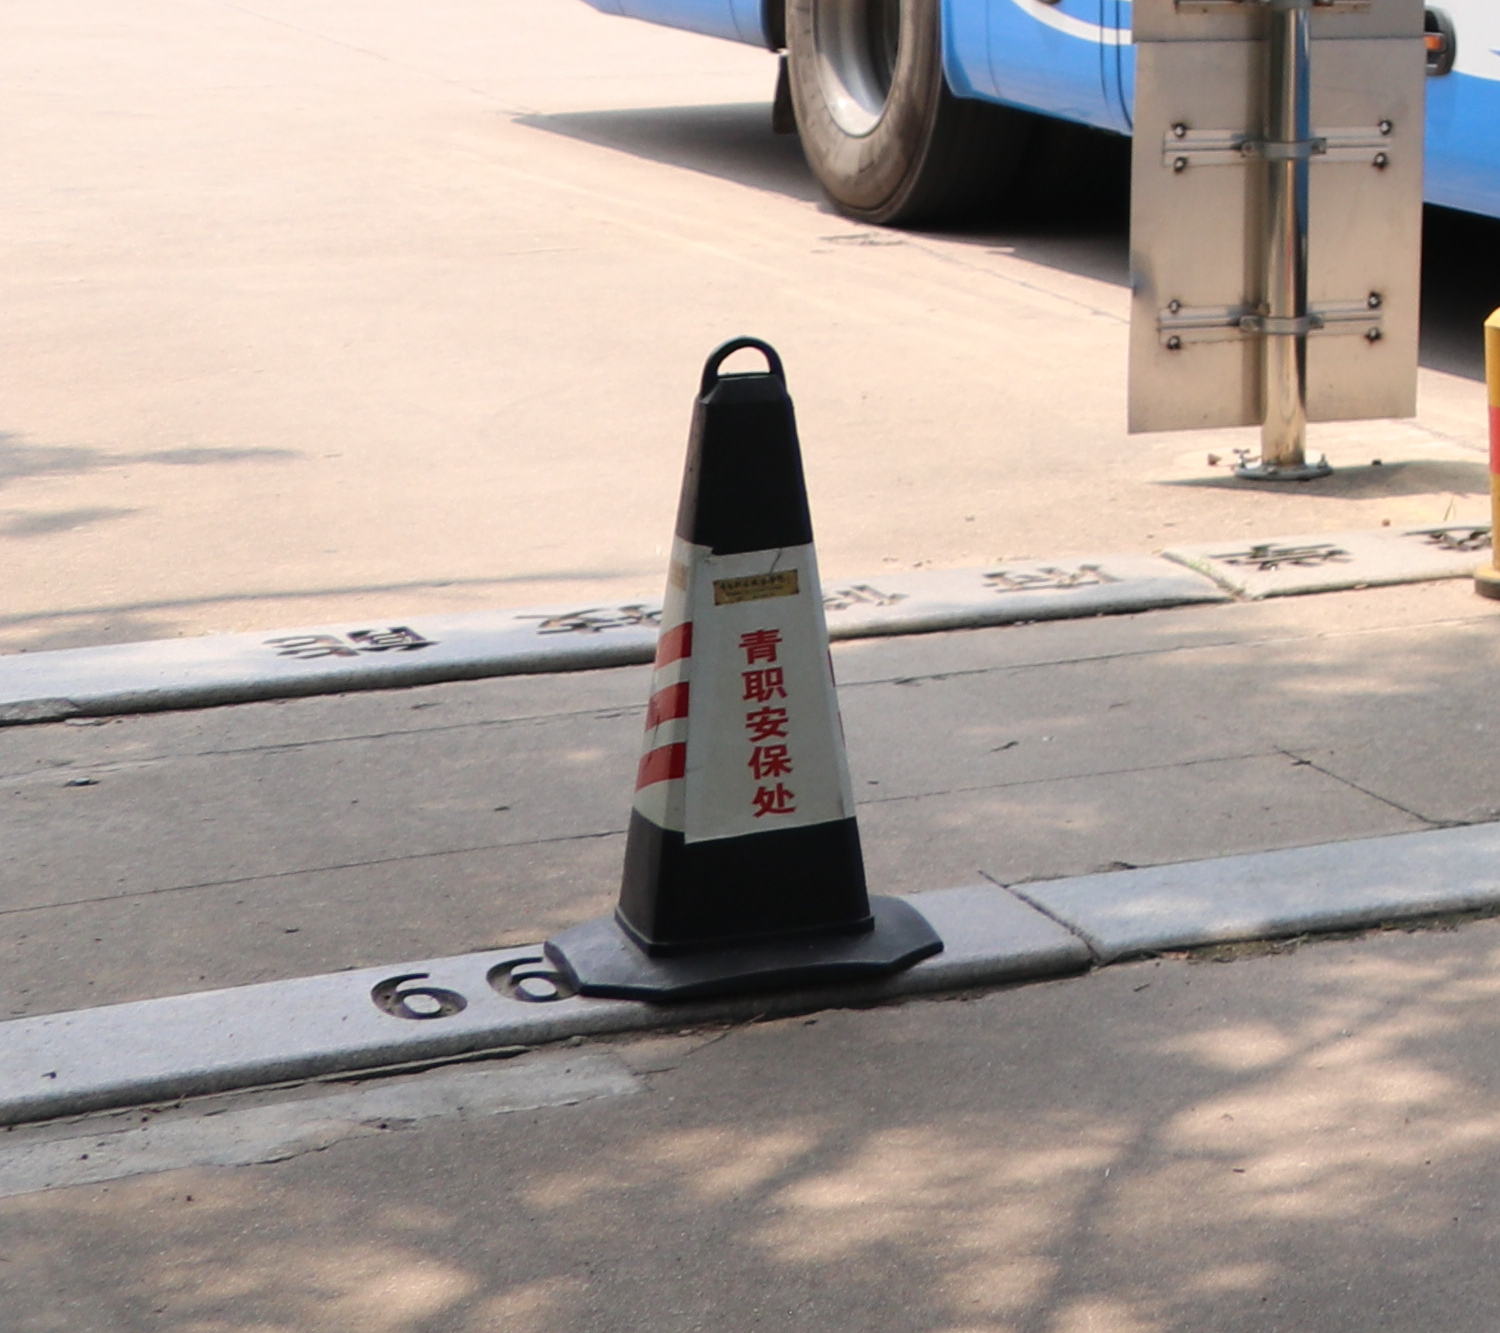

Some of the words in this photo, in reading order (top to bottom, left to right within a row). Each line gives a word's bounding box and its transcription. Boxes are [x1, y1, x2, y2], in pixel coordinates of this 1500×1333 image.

[738, 628, 797, 819] 青职安保处
